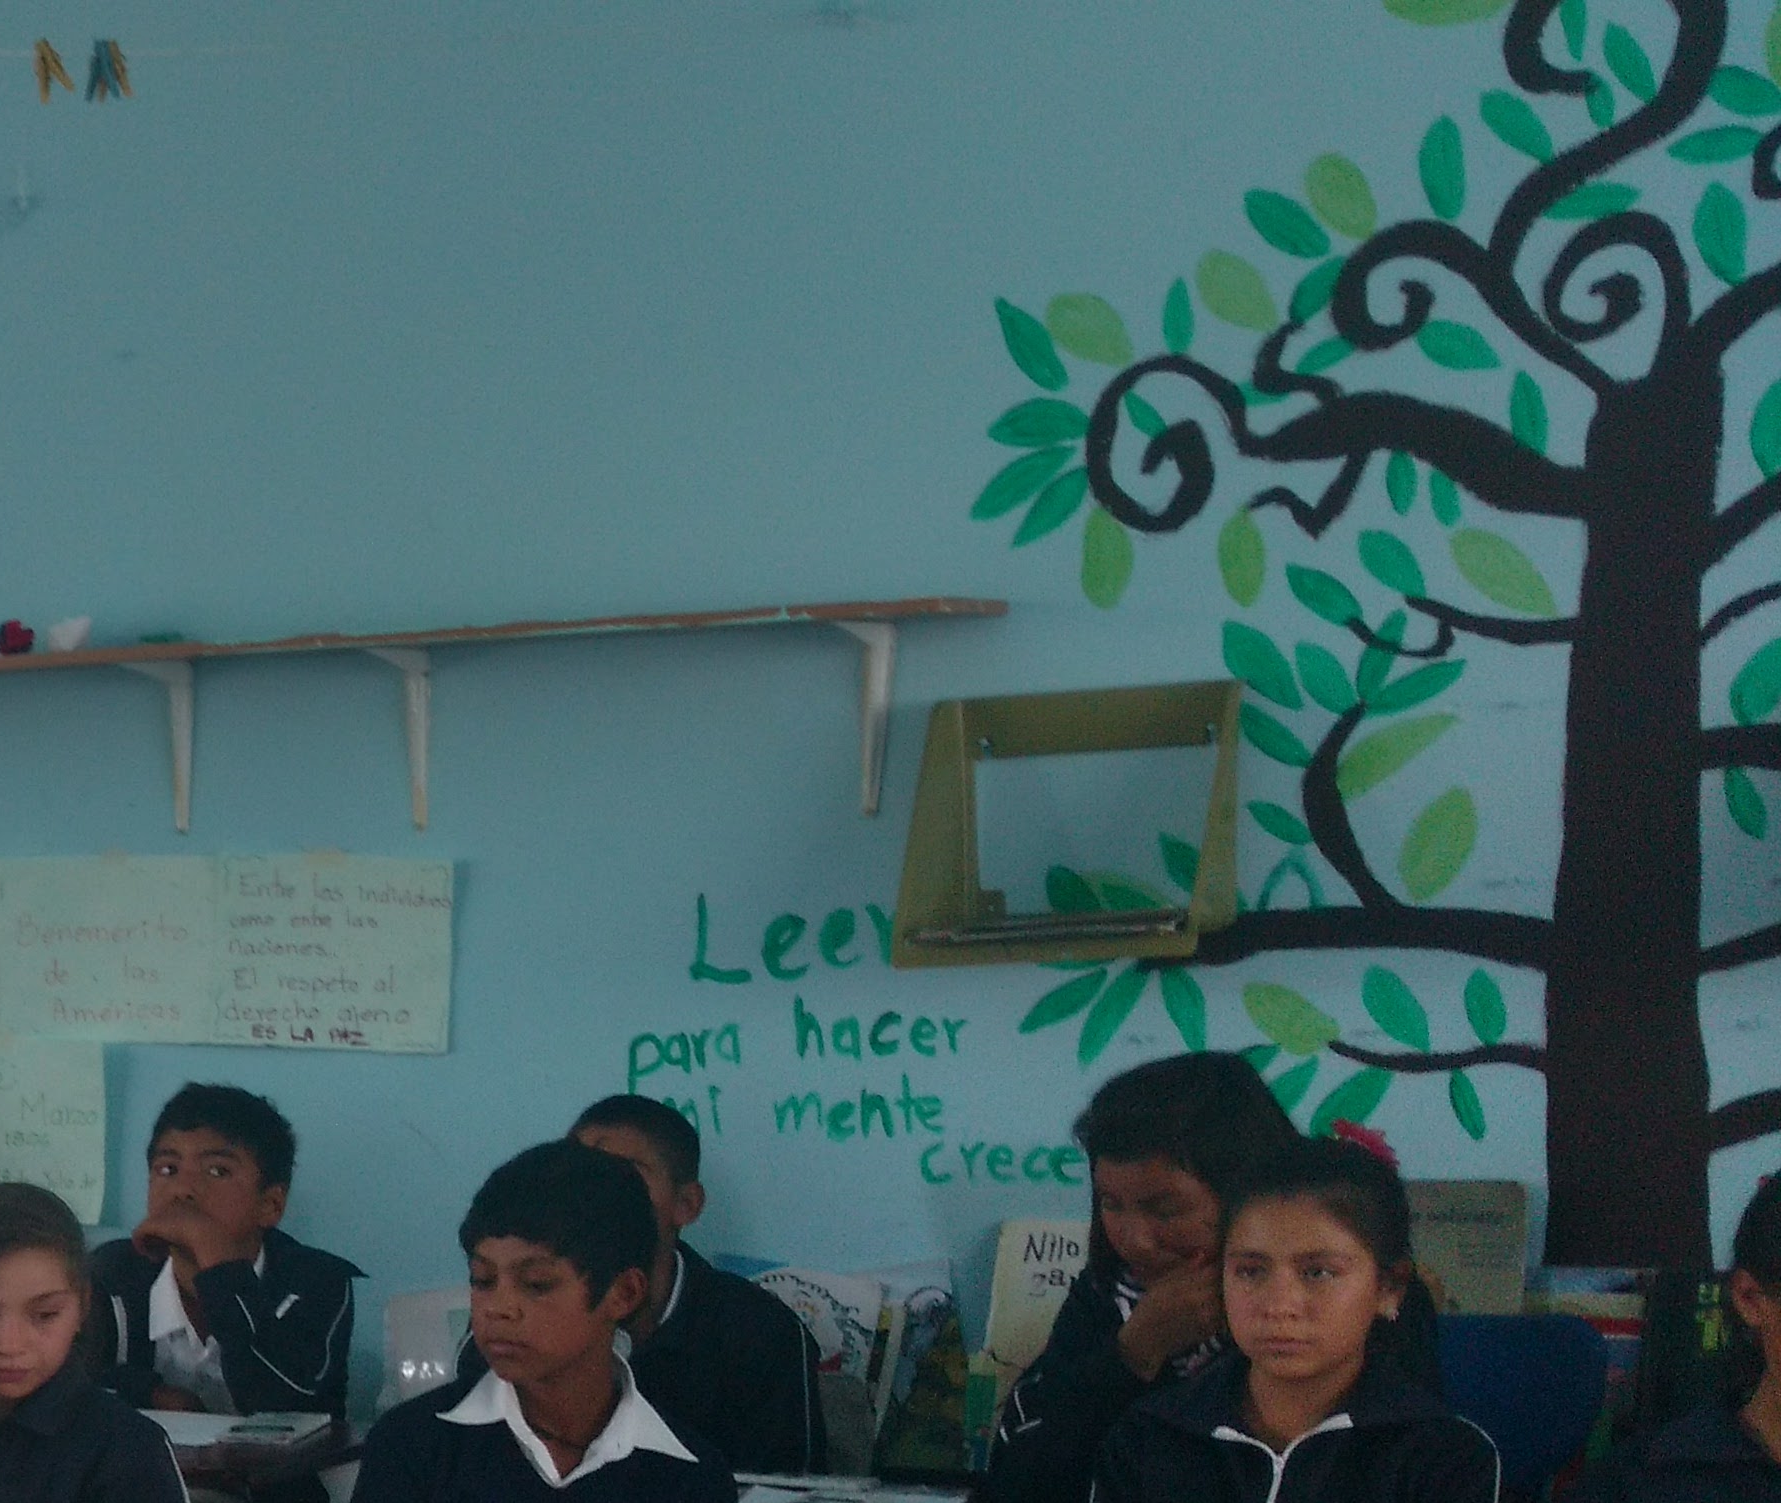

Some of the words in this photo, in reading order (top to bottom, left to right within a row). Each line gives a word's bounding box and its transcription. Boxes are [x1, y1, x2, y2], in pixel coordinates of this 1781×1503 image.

[234, 967, 258, 992] El
[373, 964, 399, 995] al
[251, 1024, 278, 1039] ES
[290, 1024, 315, 1043] LA
[627, 1023, 740, 1096] para
[794, 995, 967, 1059] hacer
[774, 1073, 943, 1140] mente
[920, 1141, 1084, 1186] crece
